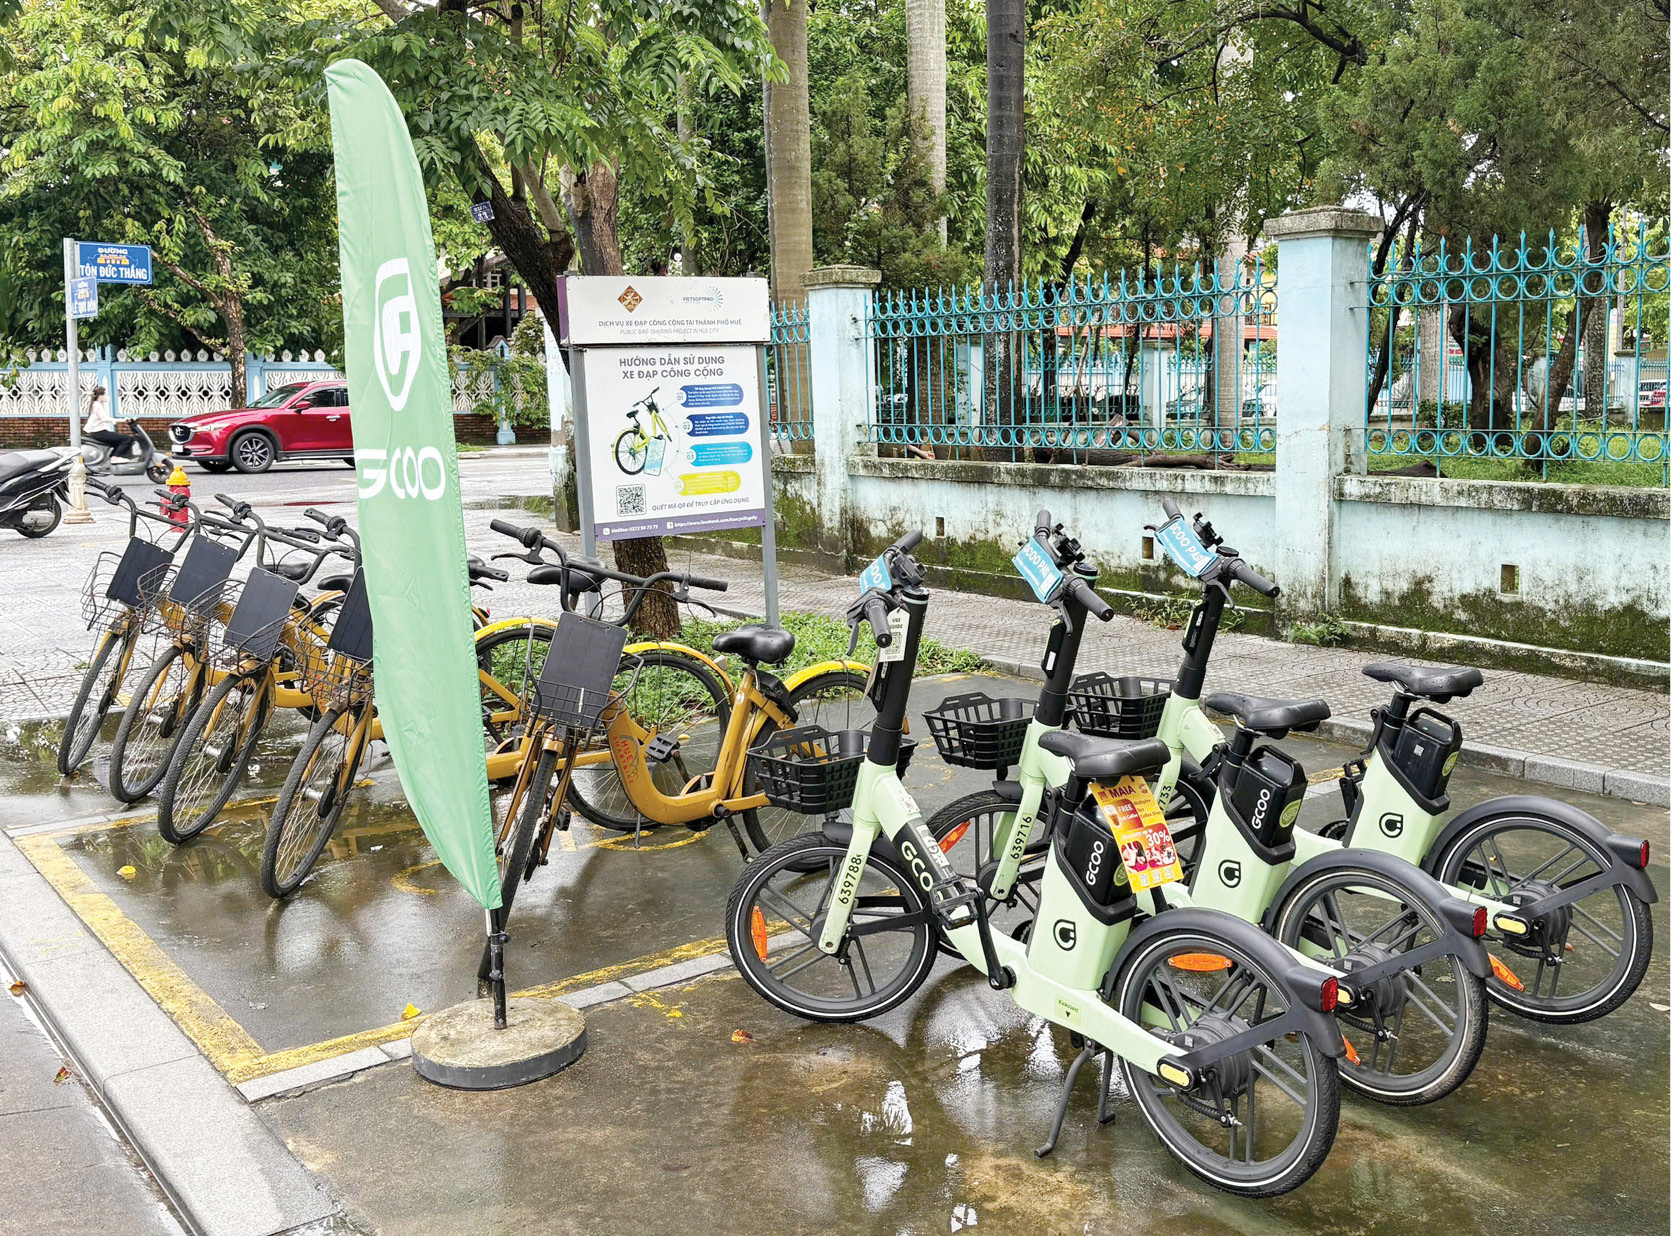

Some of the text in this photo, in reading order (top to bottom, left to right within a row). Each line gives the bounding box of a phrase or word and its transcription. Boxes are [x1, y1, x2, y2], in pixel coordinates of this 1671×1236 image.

[97, 246, 128, 254] ĐƯỜNG
[80, 262, 148, 280] TÔN ĐỨC THẮNG
[668, 319, 685, 327] CỘNG
[619, 353, 725, 367] HƯỚNG DẪN SỬ DỤNG
[622, 366, 724, 381] XE ĐẠP CÔNG CỘNG
[354, 446, 446, 500] GCOO
[652, 502, 666, 510] QUÉT
[734, 496, 750, 505] DỤNG
[621, 739, 633, 762] HUE
[1109, 785, 1136, 798] MAIA
[1118, 804, 1133, 813] FREE
[1252, 788, 1270, 829] GCOO
[1010, 816, 1032, 860] 639716
[1146, 830, 1171, 847] 30%
[901, 841, 940, 898] GCO
[1086, 841, 1104, 885] GCOO
[839, 856, 861, 904] 639788
